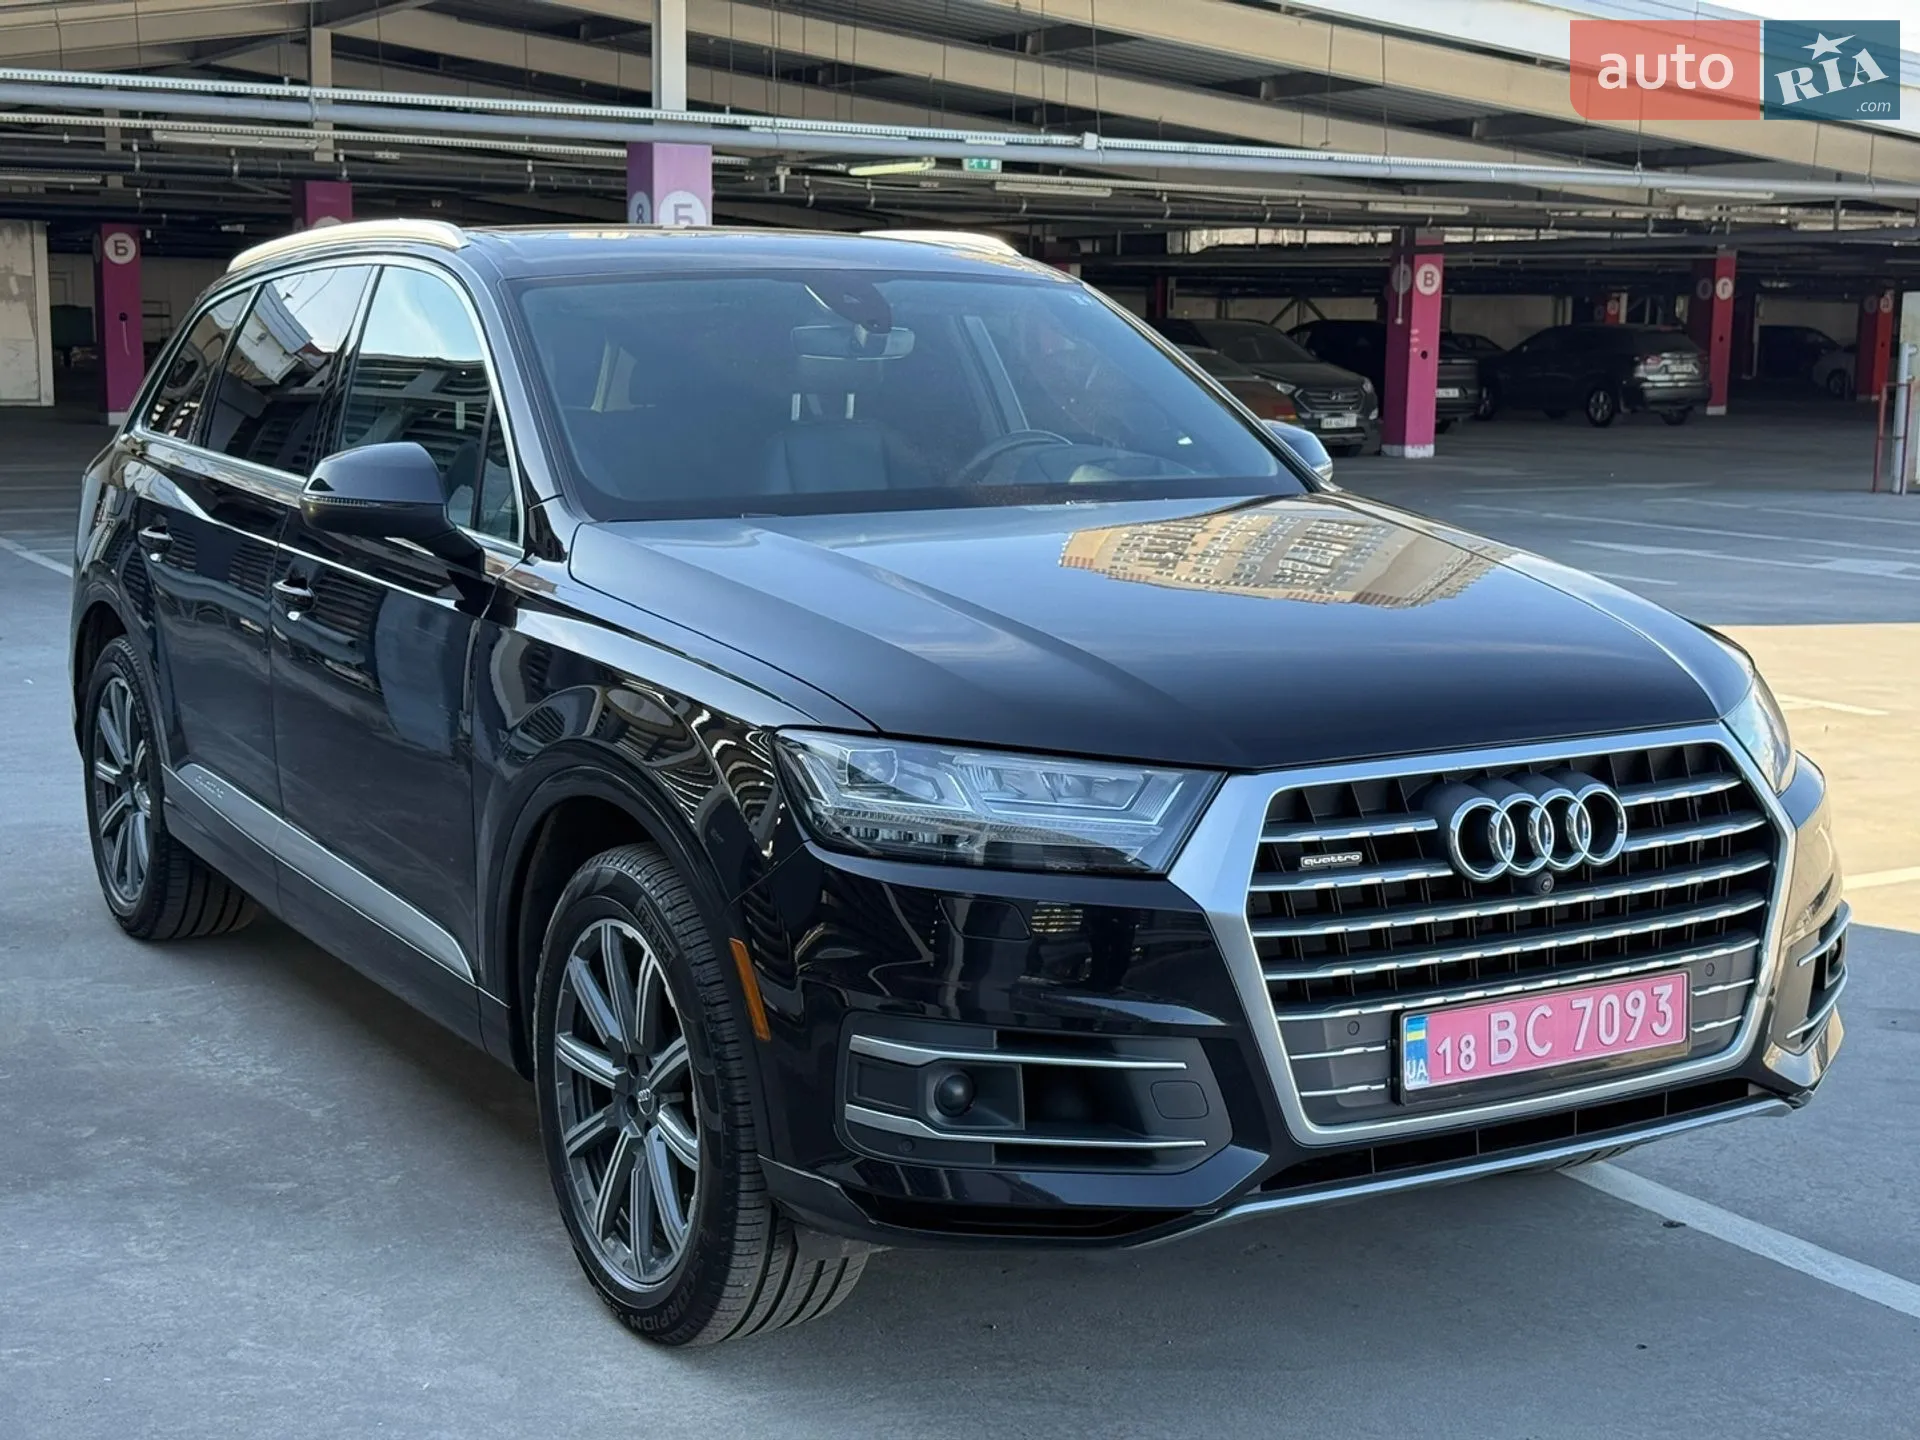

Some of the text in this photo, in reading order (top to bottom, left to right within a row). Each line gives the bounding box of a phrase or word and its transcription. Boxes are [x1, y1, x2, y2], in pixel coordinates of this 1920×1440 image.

[113, 239, 129, 257] Б
[1303, 854, 1361, 867] quattro
[1435, 983, 1674, 1076] 18 BC 7093
[1406, 1058, 1429, 1081] UA
